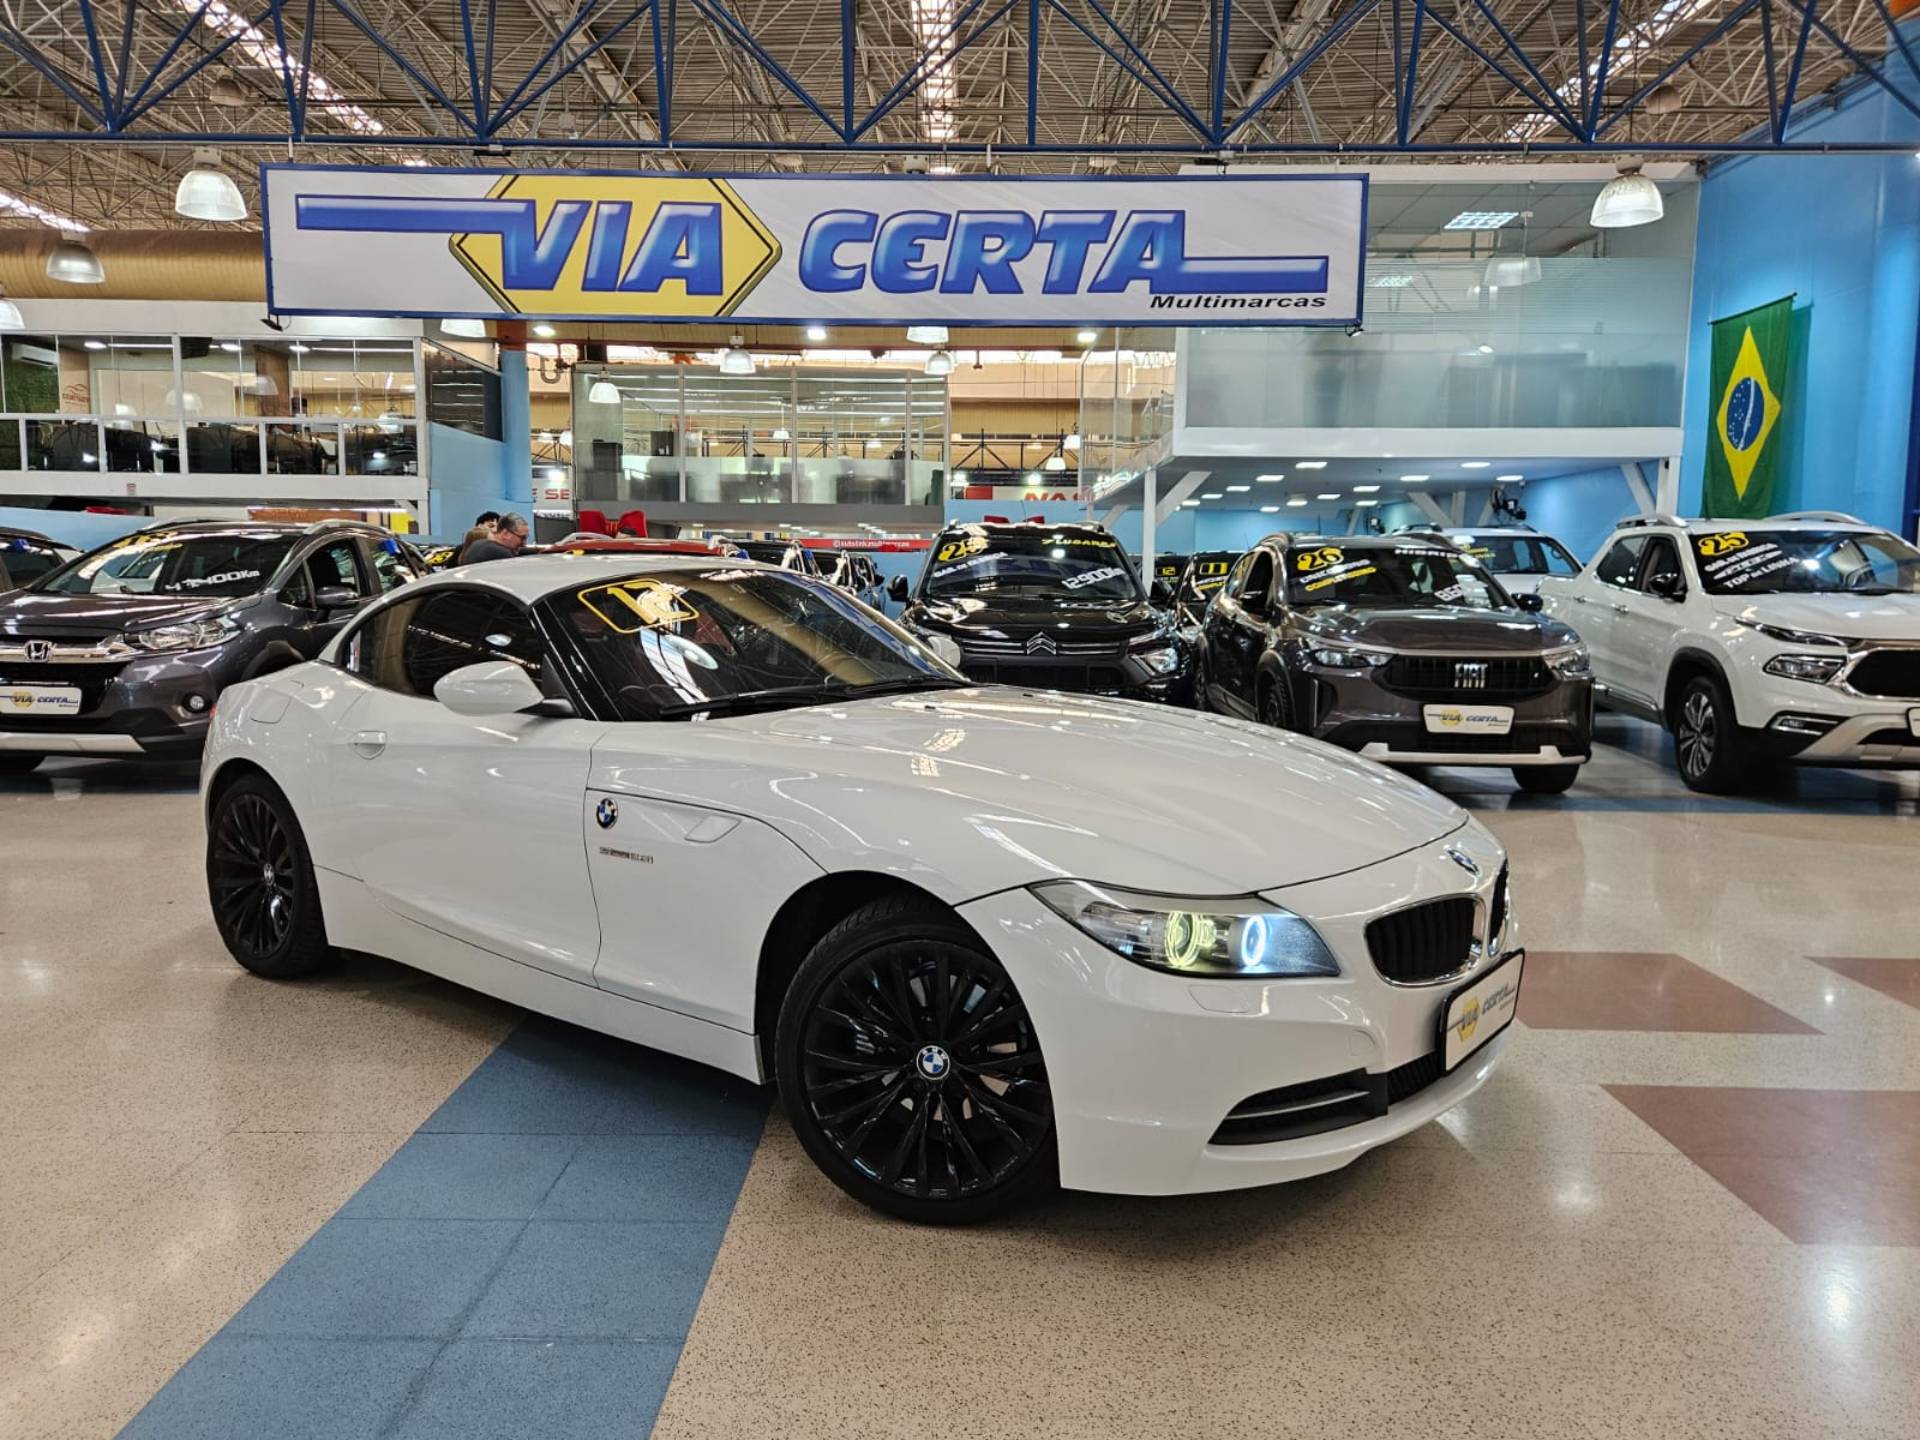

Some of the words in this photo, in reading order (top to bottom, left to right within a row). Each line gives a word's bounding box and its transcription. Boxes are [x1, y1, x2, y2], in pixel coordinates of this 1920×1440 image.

[501, 200, 722, 296] VIA
[799, 208, 1186, 295] CERTA
[1150, 294, 1328, 309] Multimarcas
[1698, 531, 1749, 555] 25
[1297, 547, 1344, 570] 26
[1454, 663, 1488, 688] FIAT
